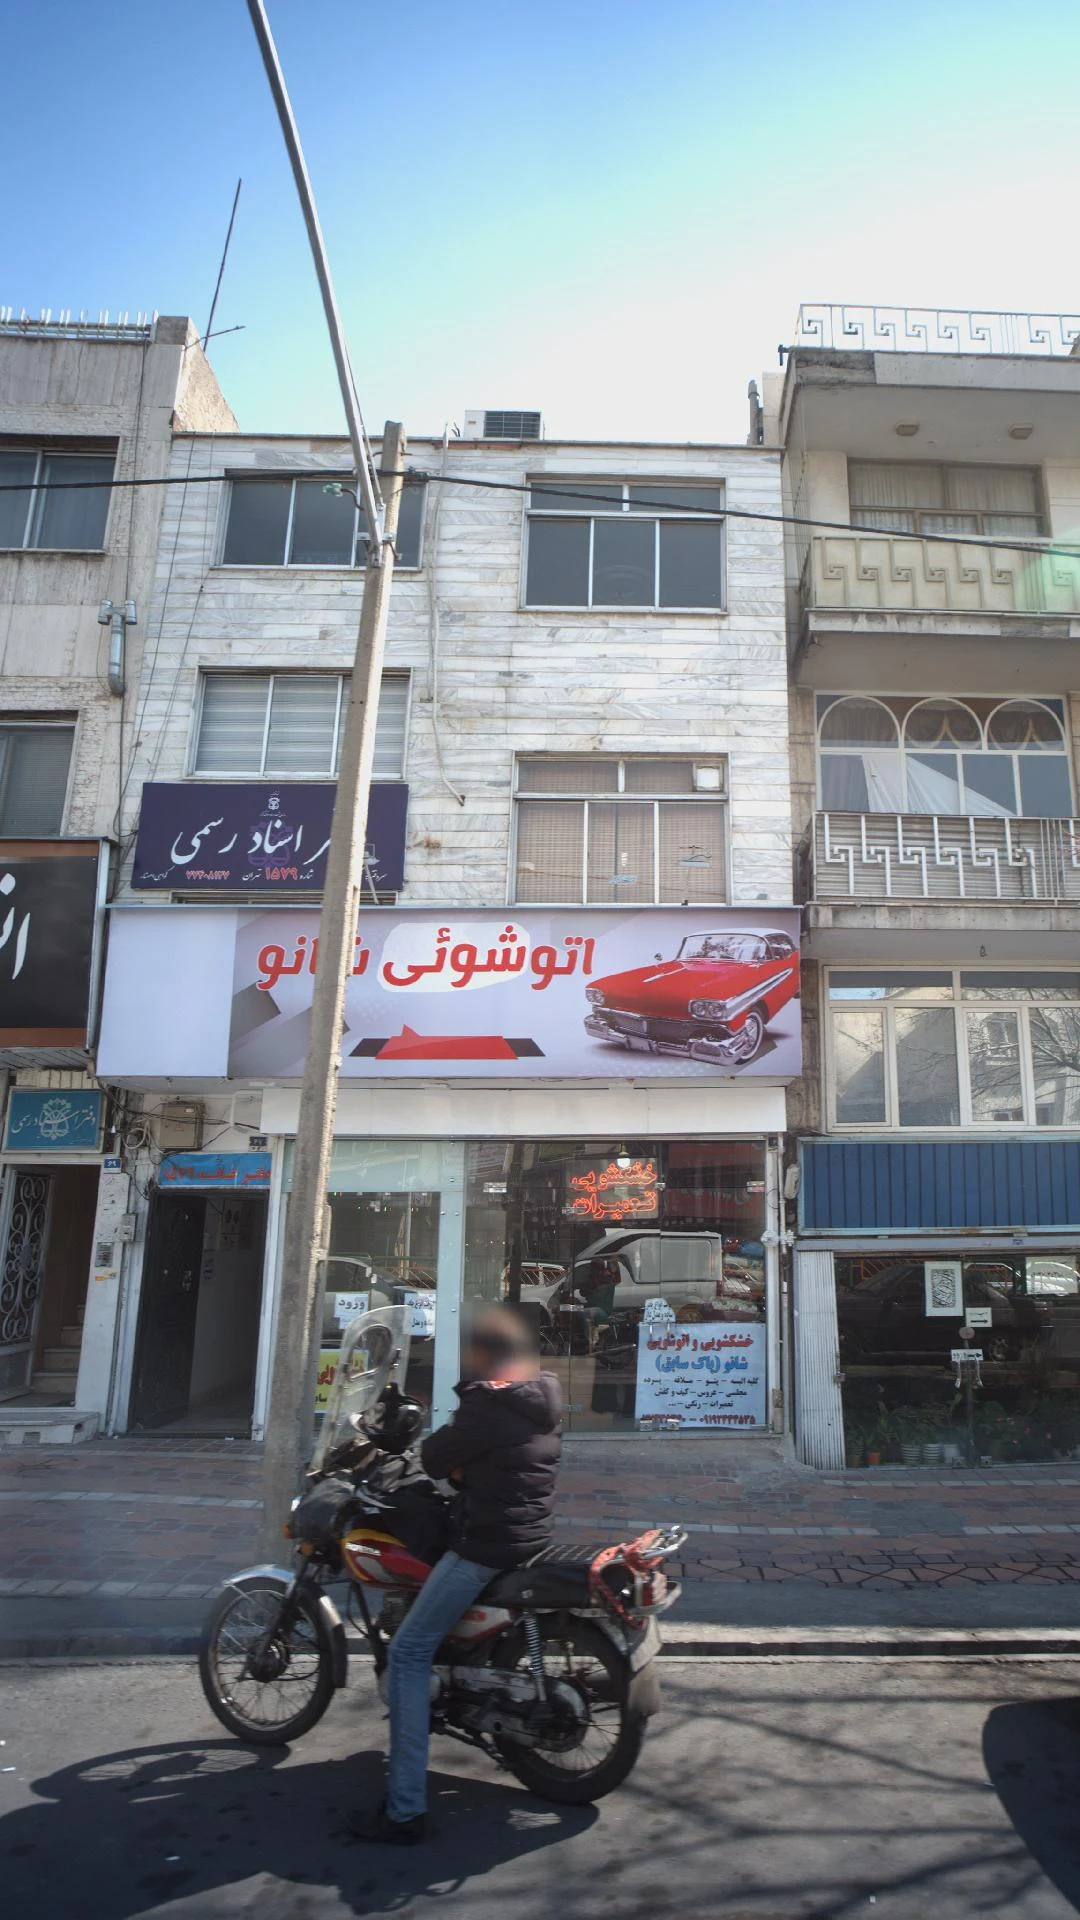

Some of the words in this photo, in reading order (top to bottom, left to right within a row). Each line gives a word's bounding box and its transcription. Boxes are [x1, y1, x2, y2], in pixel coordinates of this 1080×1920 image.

[170, 816, 238, 865] رسمی
[248, 819, 302, 854] اسناد
[265, 866, 298, 881] ۱۵۷۹
[572, 1190, 657, 1220] تعمیرات
[338, 1299, 365, 1311] ورود
[724, 1355, 749, 1373] شانو
